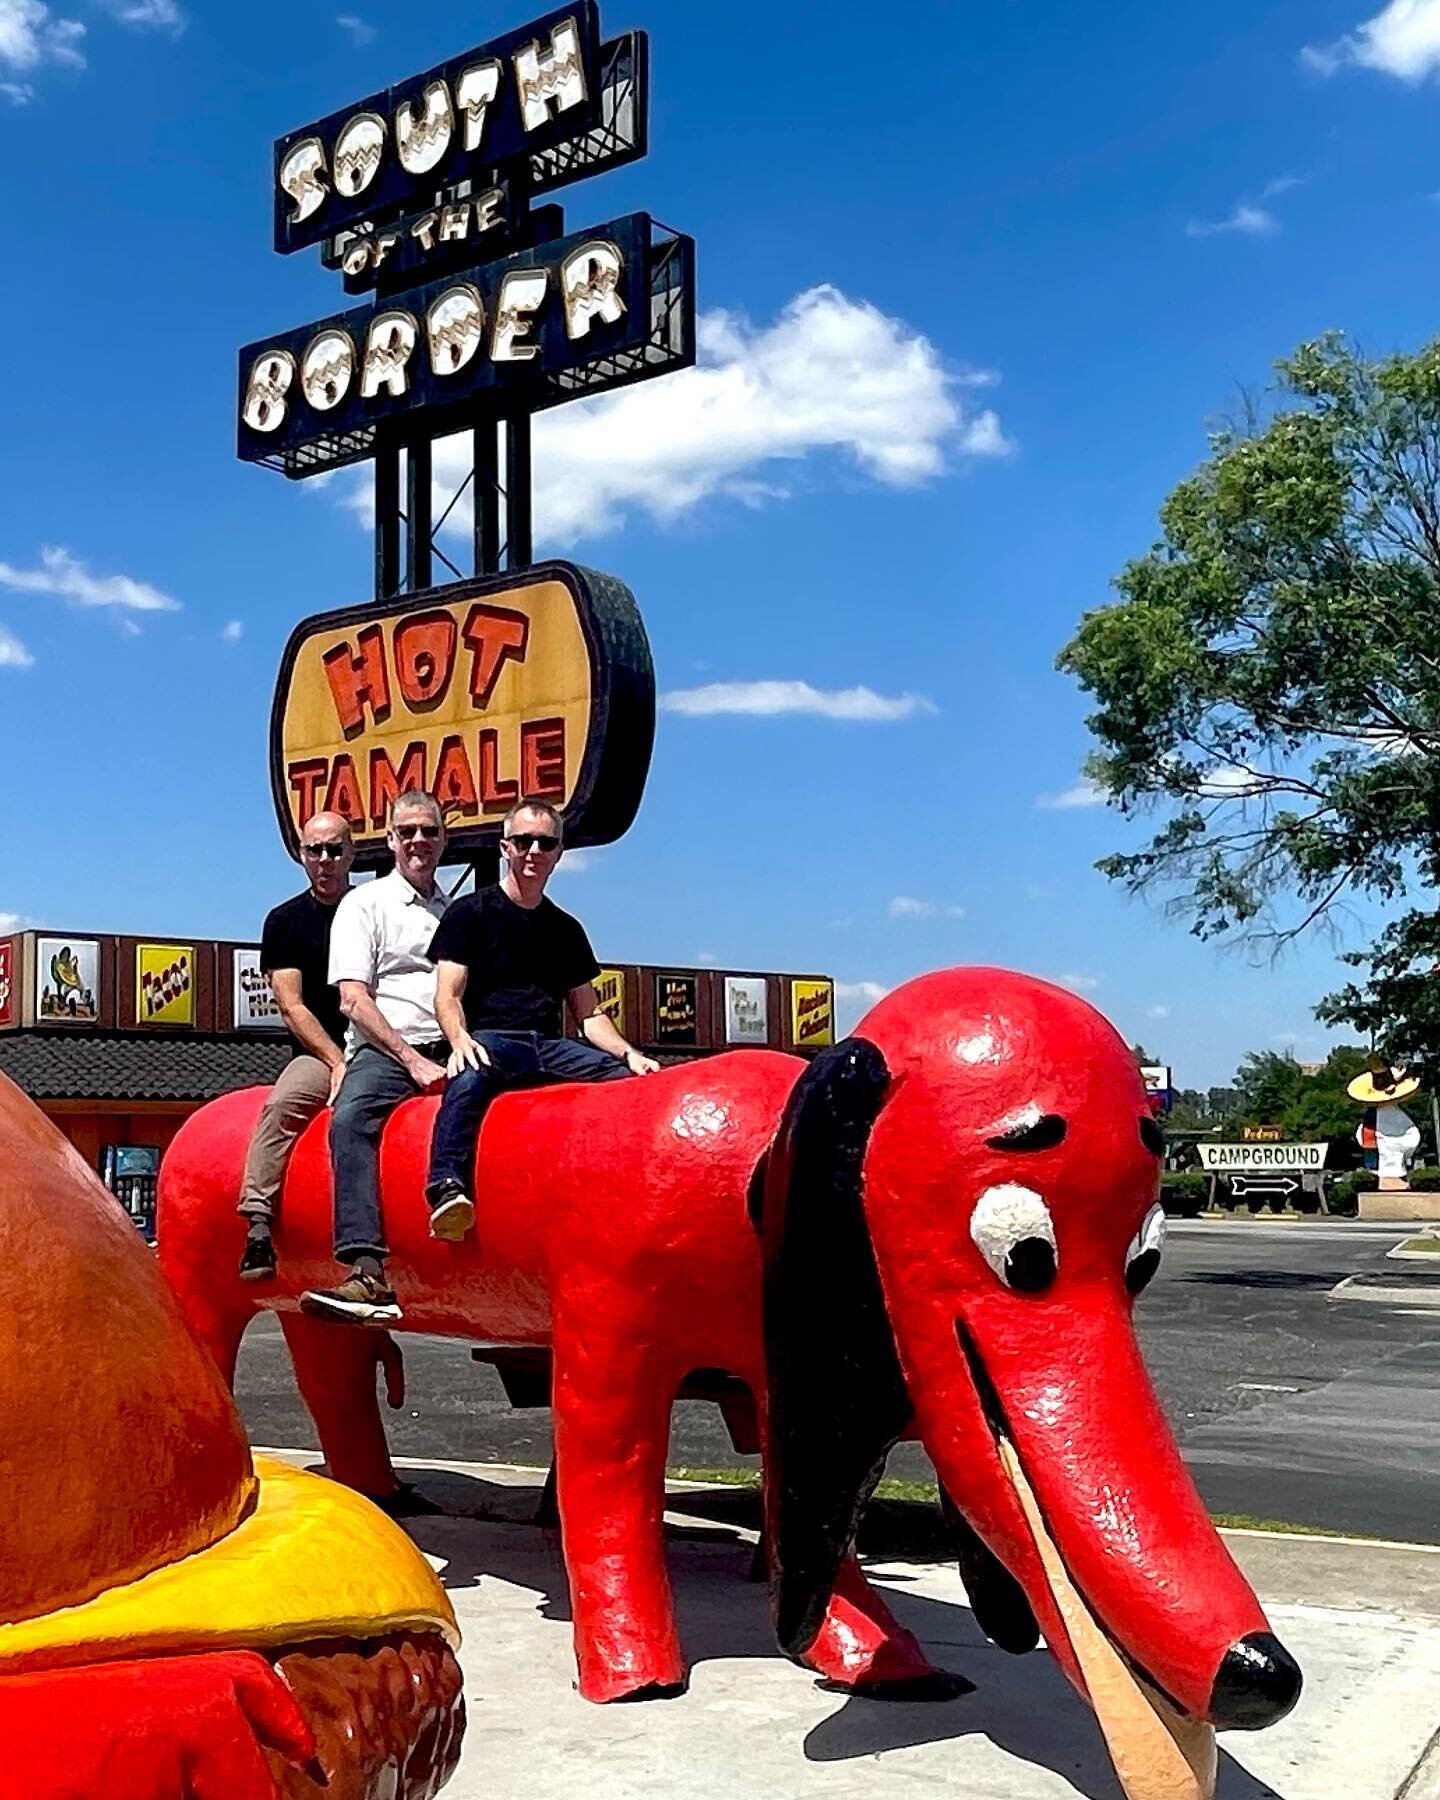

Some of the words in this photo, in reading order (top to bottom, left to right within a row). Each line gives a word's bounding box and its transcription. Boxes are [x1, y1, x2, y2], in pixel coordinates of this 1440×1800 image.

[280, 15, 588, 224] SOUTH
[341, 235, 401, 275] OF
[410, 188, 508, 251] THE
[242, 239, 628, 432] BORDER
[322, 604, 530, 742] HOT
[288, 717, 566, 834] TAMALE
[1208, 1147, 1320, 1165] CAMPGROUND
